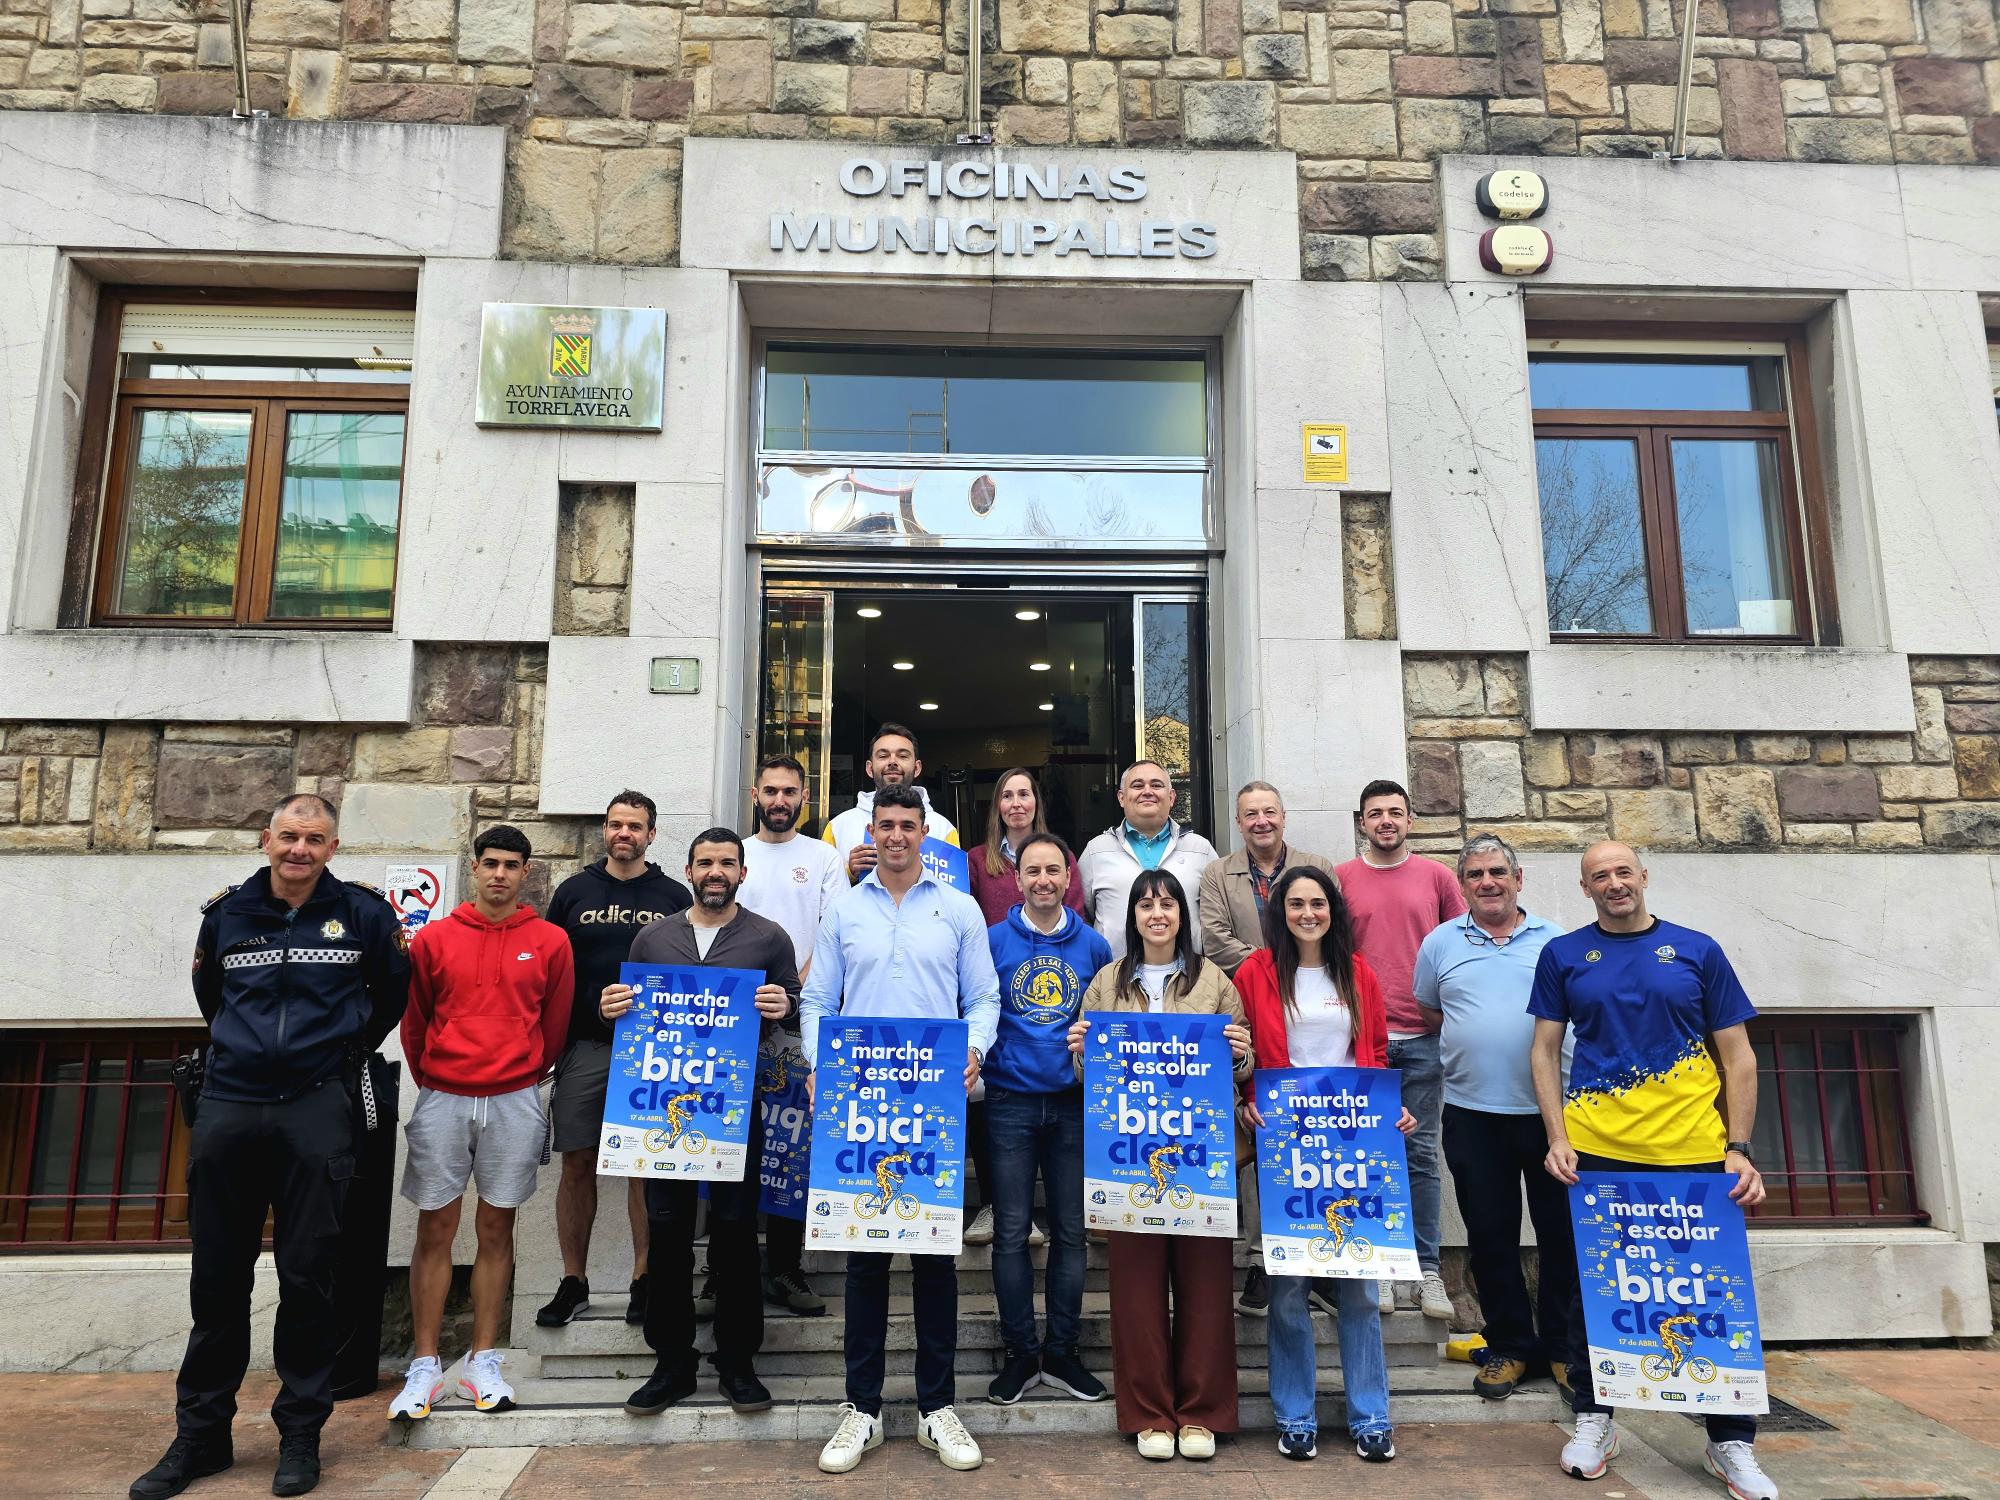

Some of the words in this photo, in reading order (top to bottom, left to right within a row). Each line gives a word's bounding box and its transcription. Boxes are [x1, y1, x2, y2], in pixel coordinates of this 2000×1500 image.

[838, 158, 1148, 201] OFICINAS
[769, 212, 1218, 258] MUNICIPALES
[505, 384, 633, 401] AYUNTAMIENTO
[506, 400, 632, 418] TORRELAVEGA
[669, 664, 681, 687] 3
[1038, 958, 1047, 966] EL
[1047, 958, 1078, 990] SALADOR
[652, 988, 730, 1008] marcha
[662, 1008, 740, 1028] escolar
[656, 1029, 682, 1043] en
[1118, 1035, 1199, 1055] marcha
[851, 1040, 933, 1061] marcha
[864, 1061, 945, 1082] escolar
[1132, 1055, 1212, 1076] escolar
[859, 1086, 886, 1101] en
[1128, 1079, 1154, 1094] en
[1288, 1088, 1369, 1108] marcha
[1304, 1108, 1382, 1128] escolar
[765, 1139, 788, 1153] en
[1300, 1134, 1328, 1147] en
[1129, 1169, 1147, 1177] ABRIL
[1608, 1196, 1704, 1218] marcha
[1627, 1218, 1720, 1240] escolar
[1625, 1244, 1657, 1259] en
[1638, 1339, 1659, 1347] ABRIL
